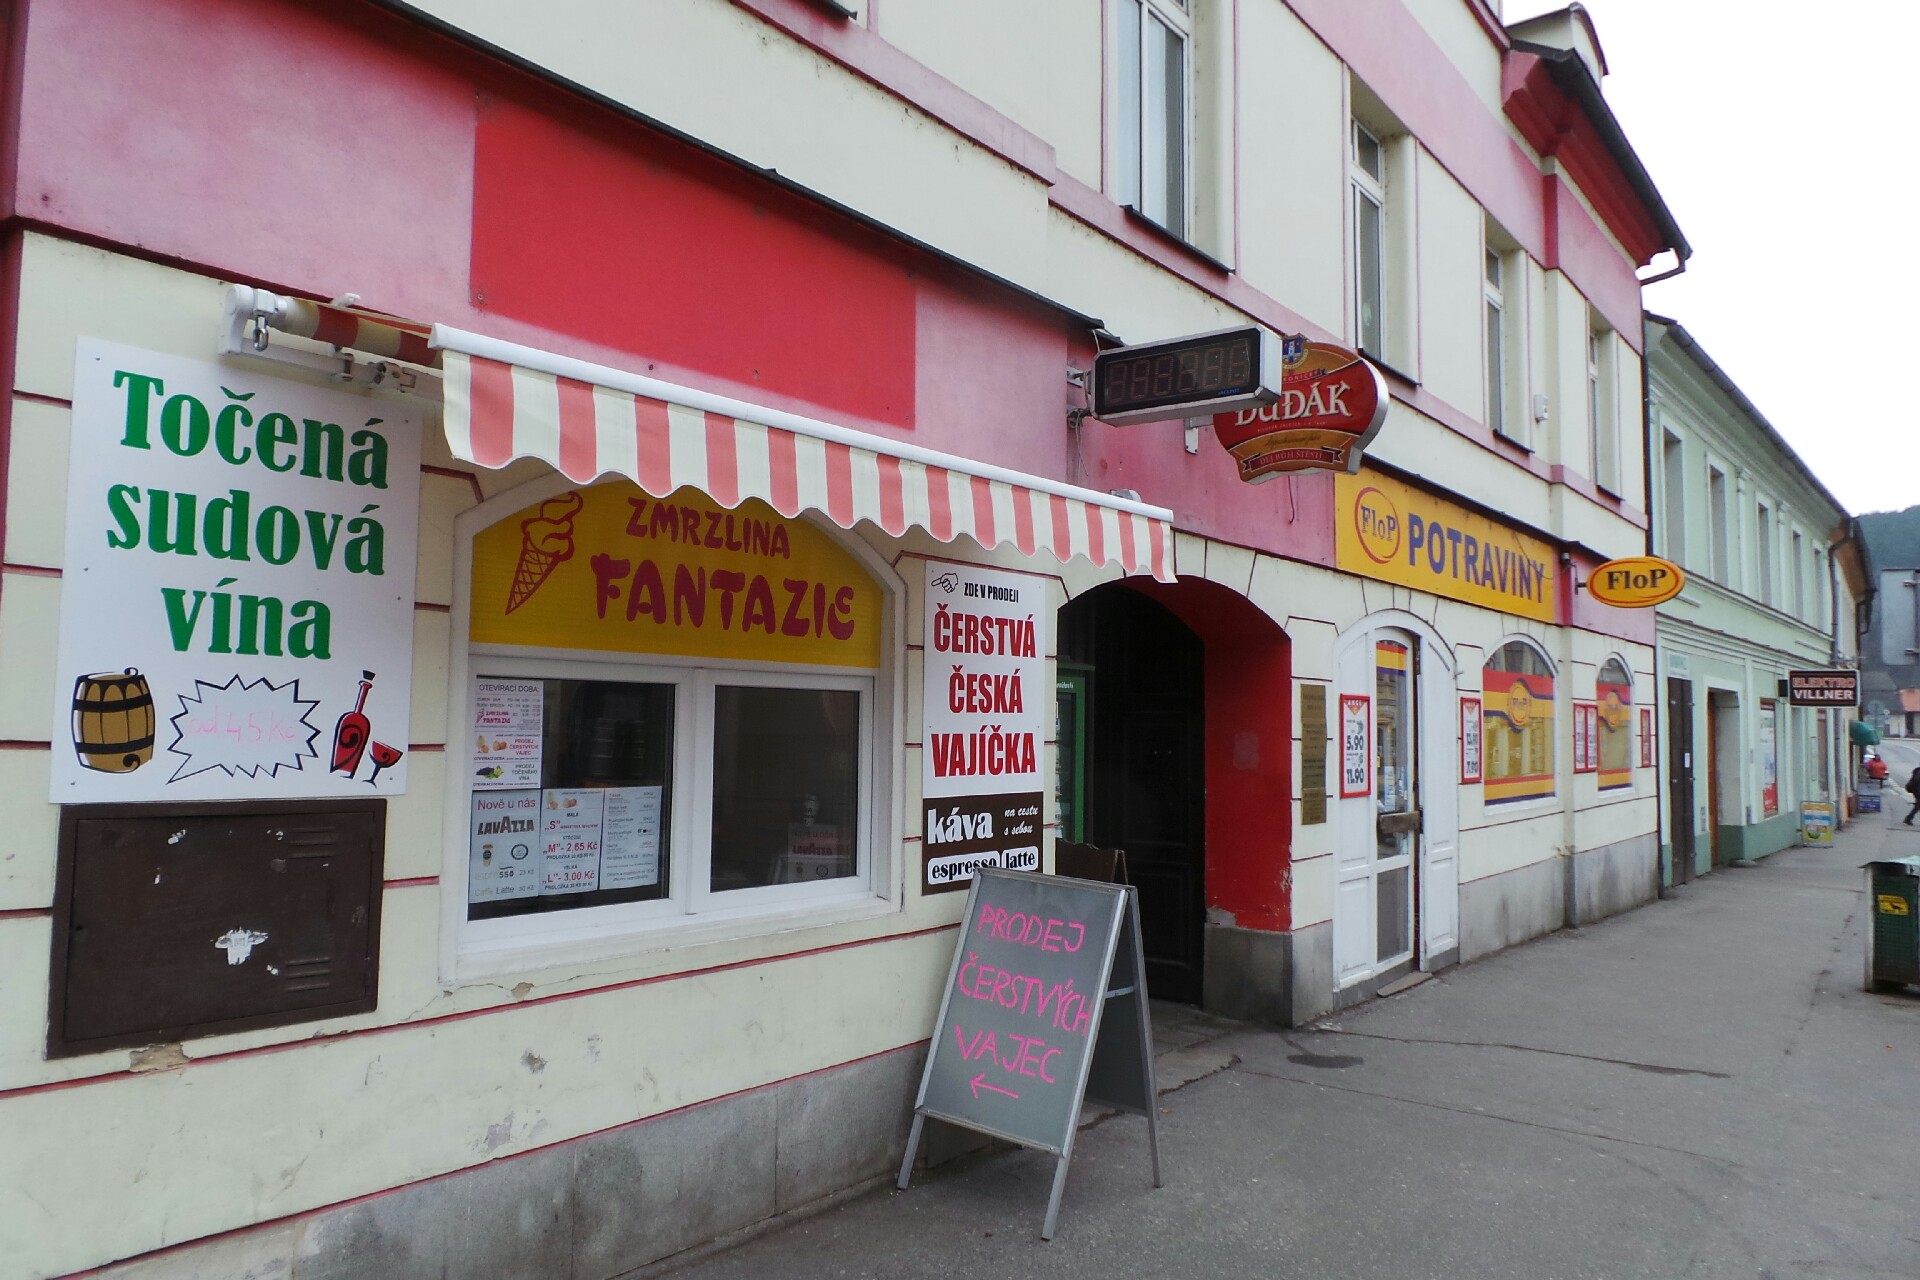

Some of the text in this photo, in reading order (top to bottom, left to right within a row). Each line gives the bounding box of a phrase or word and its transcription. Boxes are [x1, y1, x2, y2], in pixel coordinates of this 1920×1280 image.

[113, 369, 389, 490] Točená
[106, 482, 386, 577] sudová
[625, 496, 791, 560] ZMRZLINA
[1360, 504, 1396, 542] FloP
[1408, 512, 1544, 604] POTRAVINY
[589, 552, 855, 641] FANTAZIE
[963, 582, 979, 598] ZDE
[980, 584, 986, 599] V
[1606, 568, 1667, 590] FloP
[160, 577, 332, 660] vína
[933, 603, 1036, 658] ČERSTVÁ
[949, 664, 1023, 714] ČESKÁ
[1793, 689, 1854, 700] VILLNER
[931, 724, 1037, 777] VAJÍČKA
[1346, 735, 1364, 751] 5.90
[477, 797, 536, 811] Nově u nás
[477, 815, 535, 836] LAVAZZA
[927, 805, 1039, 845] káva na cestu
[1011, 820, 1033, 836] sebou
[587, 841, 598, 851] Kč
[1005, 851, 1036, 869] latte
[584, 870, 595, 880] Kč
[931, 857, 997, 881] espresso
[976, 902, 1086, 953] PRODEJ
[958, 951, 1092, 1037] ČERSTVÝCH
[953, 1024, 1063, 1083] VAJEC
